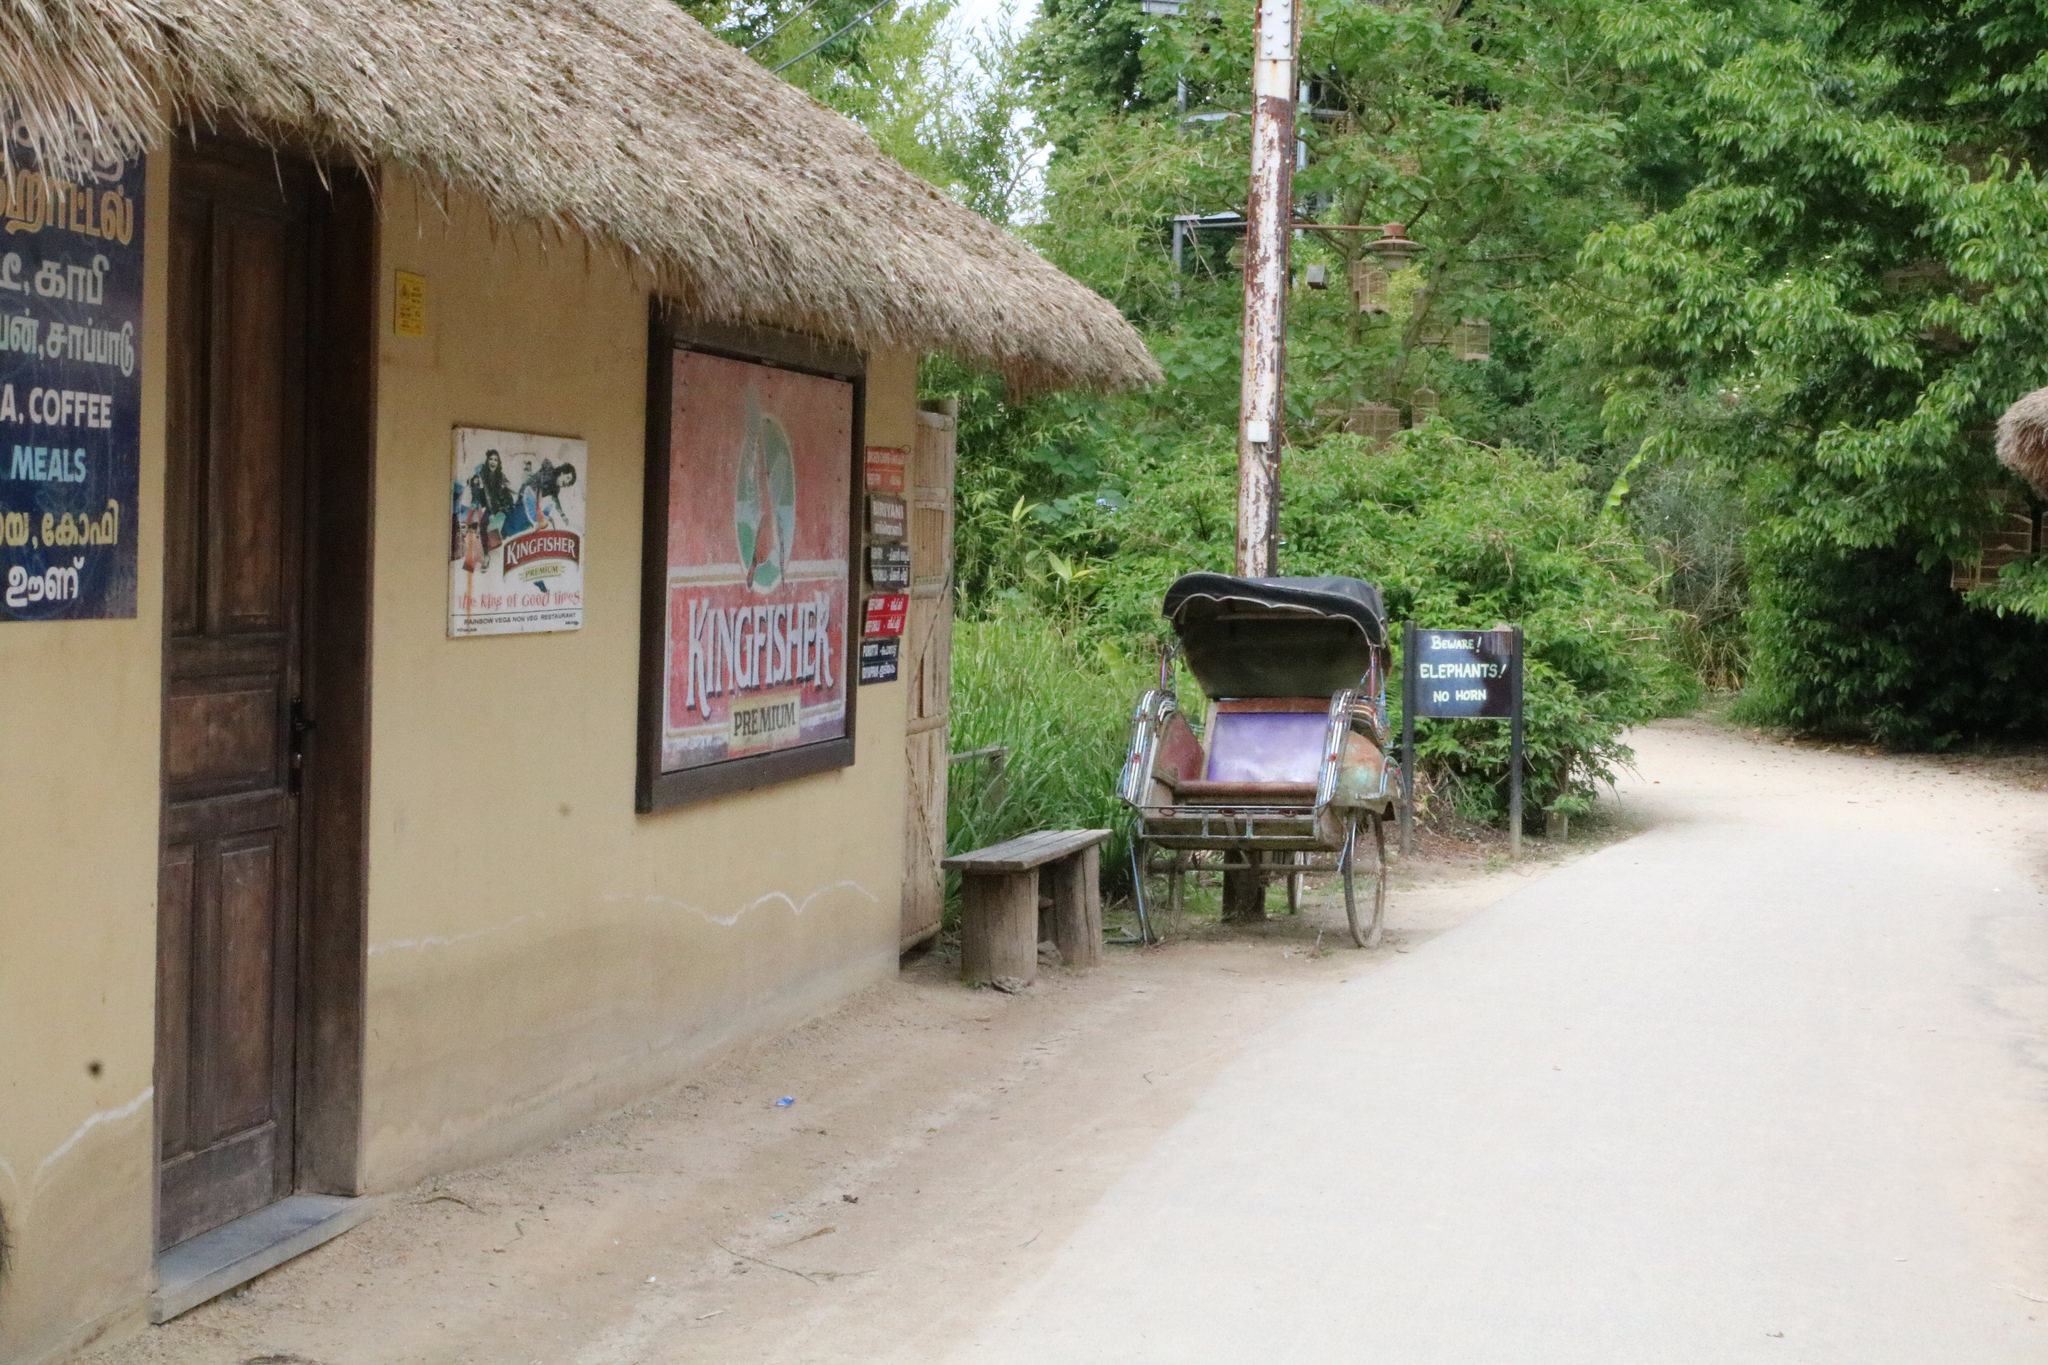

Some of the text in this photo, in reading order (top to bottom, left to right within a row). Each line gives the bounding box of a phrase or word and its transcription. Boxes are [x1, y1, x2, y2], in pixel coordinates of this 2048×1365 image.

[29, 387, 112, 428] COFFEE
[10, 444, 87, 483] MEALS
[506, 537, 576, 565] KINGFISHER
[525, 565, 559, 577] PREMIUM
[506, 593, 517, 608] of
[684, 591, 835, 720] KINGFISHER
[1419, 663, 1508, 679] ELEPHANTS!
[1433, 688, 1487, 703] NO HORN
[733, 702, 797, 738] PREMIUM
